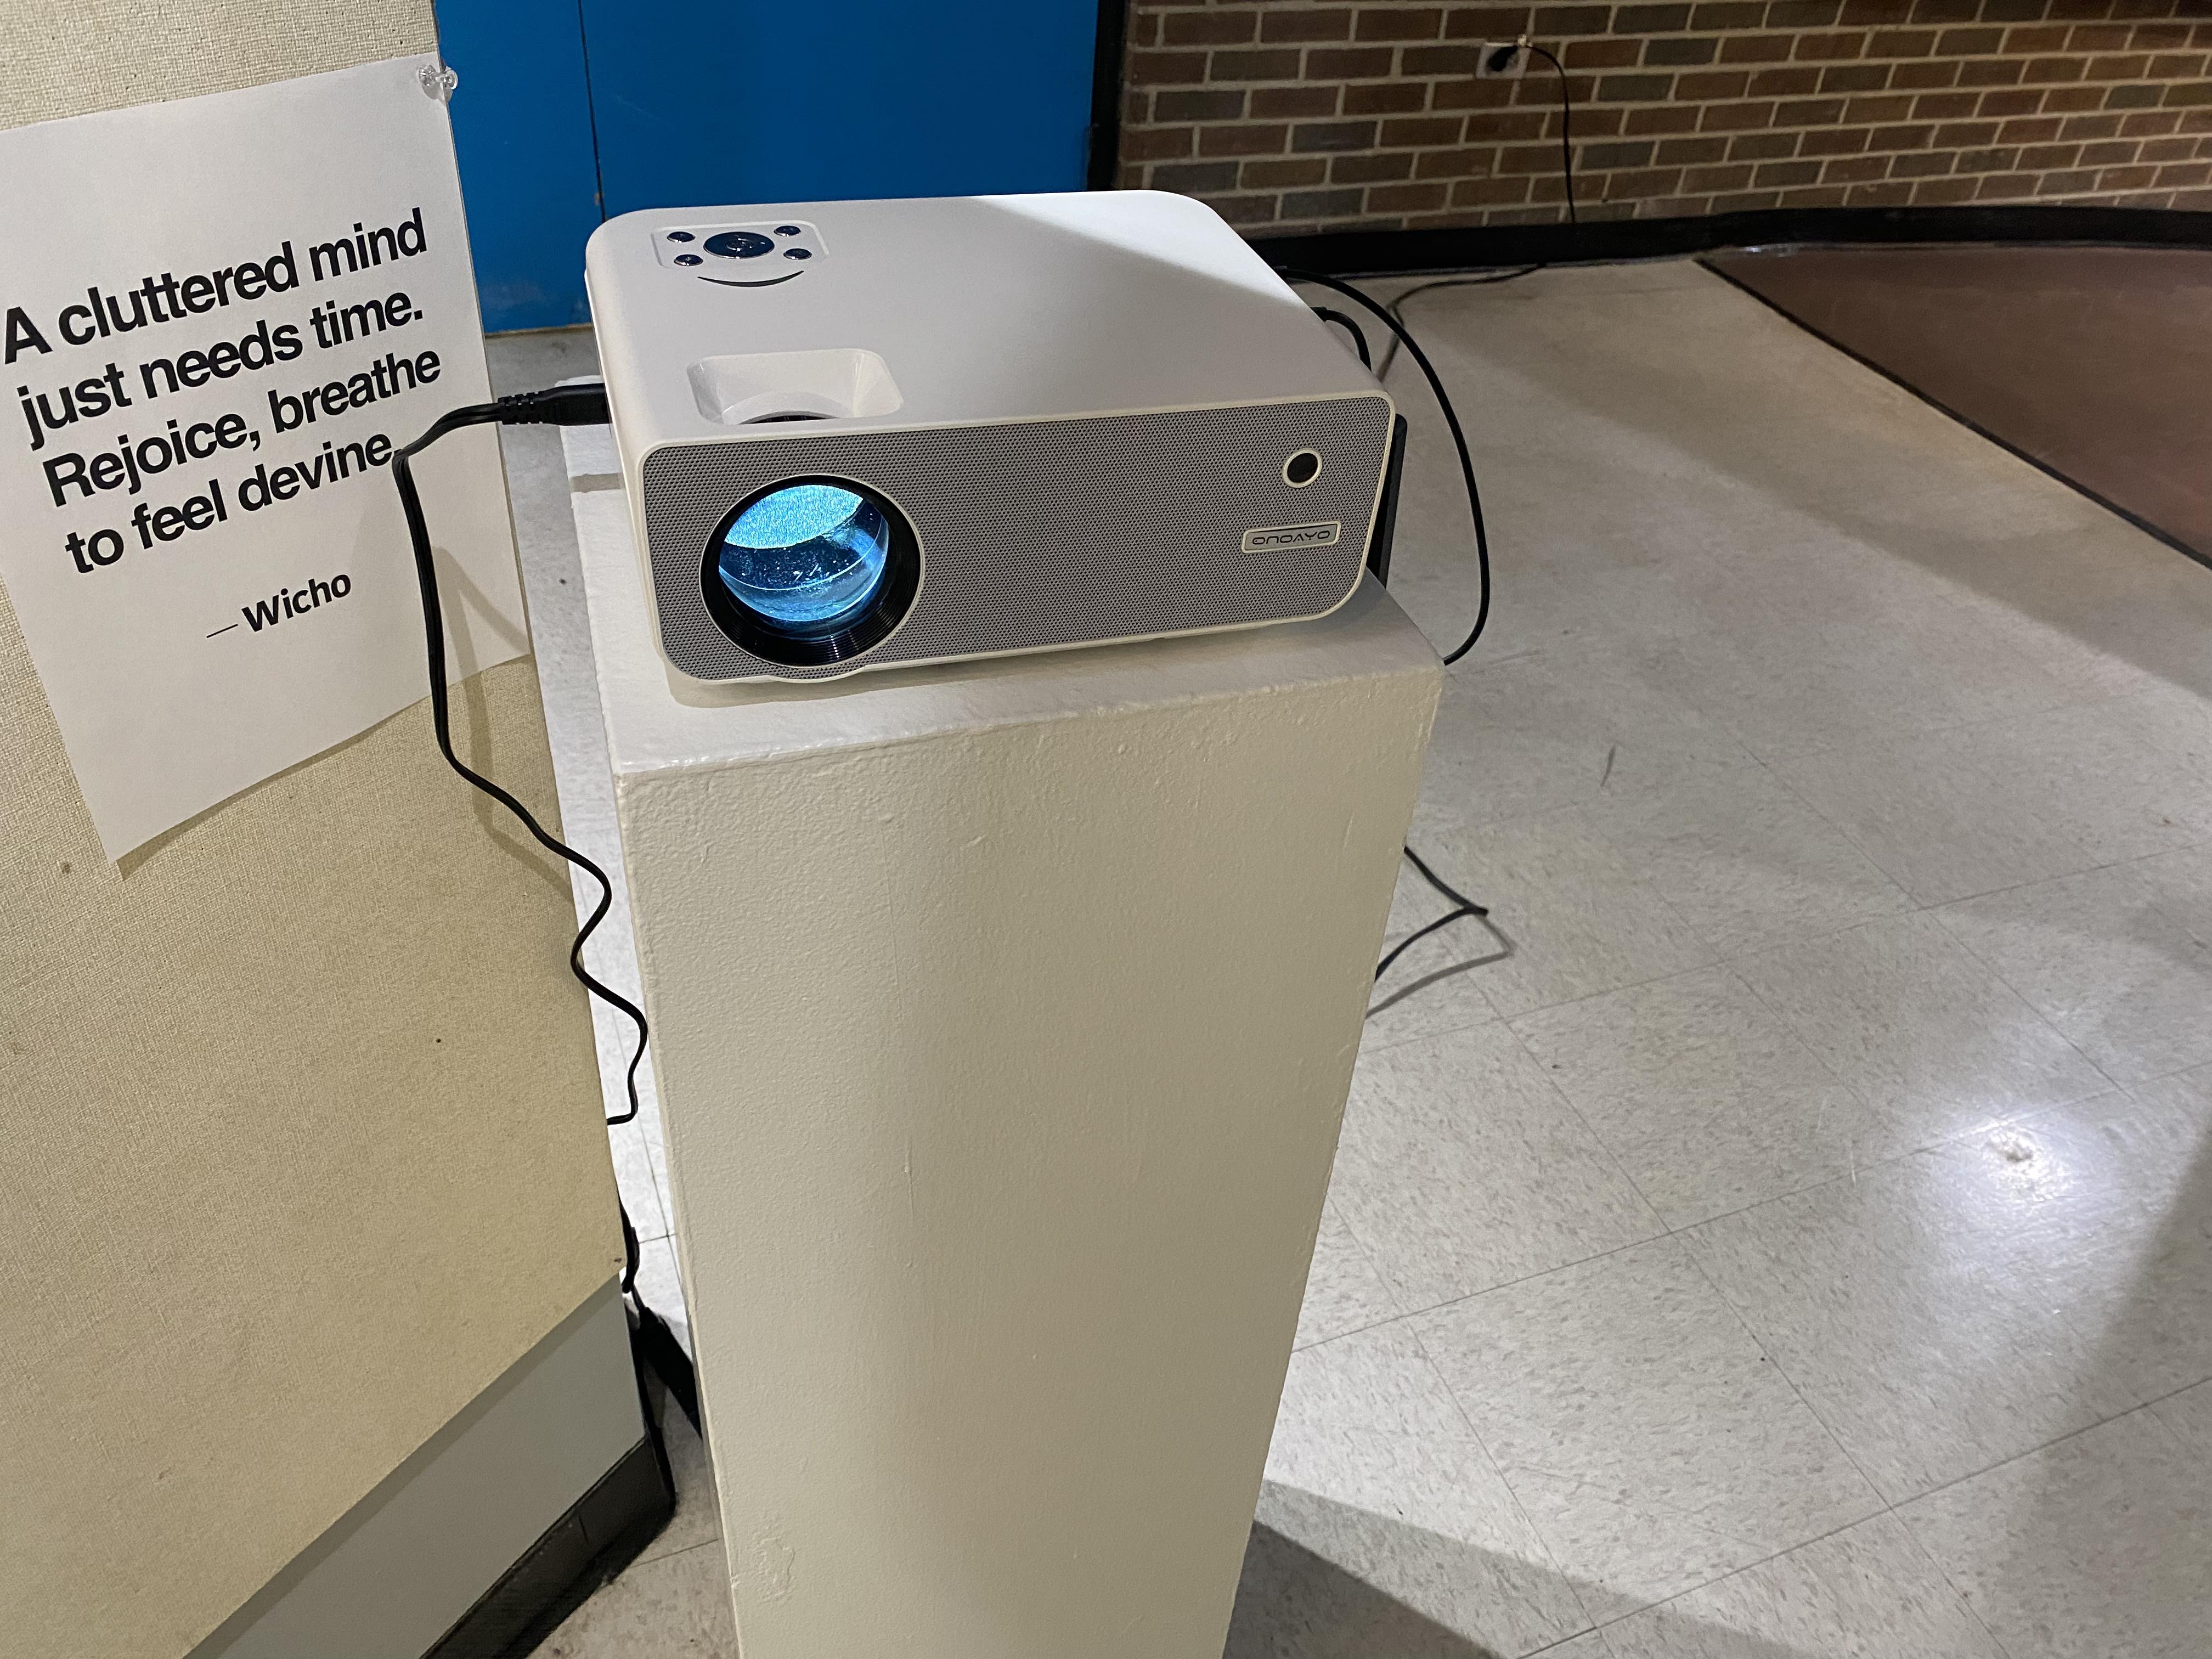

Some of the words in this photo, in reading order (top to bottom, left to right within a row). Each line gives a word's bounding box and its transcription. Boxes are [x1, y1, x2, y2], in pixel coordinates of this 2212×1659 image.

[4, 306, 53, 364] A
[58, 240, 300, 346] cluttered
[309, 207, 427, 282] mind
[16, 363, 133, 452] just
[139, 319, 303, 399] needs
[309, 290, 423, 349] time.
[42, 414, 261, 507] Rejoice,
[267, 351, 441, 434] breathe
[65, 529, 125, 574] to
[131, 478, 228, 550] feel
[241, 574, 352, 632] Wicho
